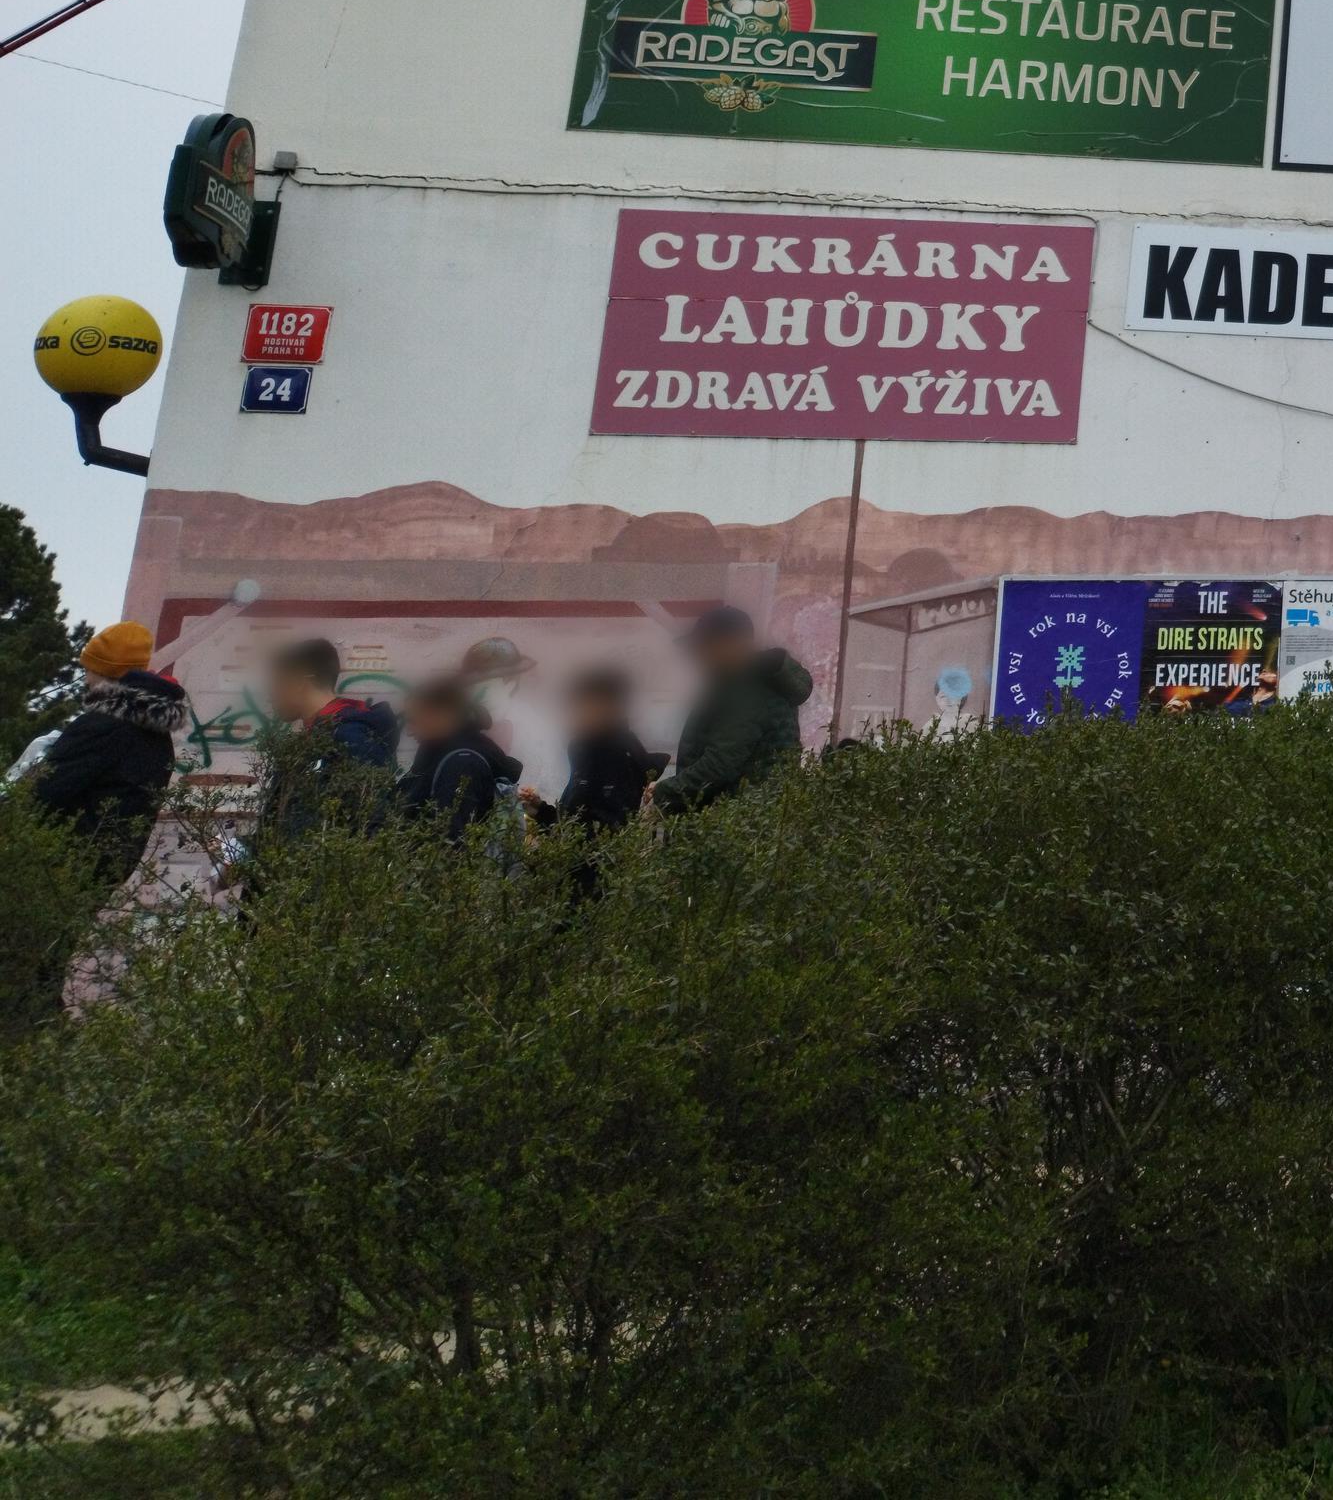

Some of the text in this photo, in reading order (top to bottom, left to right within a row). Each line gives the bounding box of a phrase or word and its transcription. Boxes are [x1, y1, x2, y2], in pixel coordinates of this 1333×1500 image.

[635, 30, 860, 82] RADEGAST
[941, 55, 1200, 110] HARMONY
[205, 175, 254, 236] RADEGA
[638, 231, 1072, 283] CUKRÁRNA
[258, 311, 315, 337] 1182
[658, 291, 1041, 352] LAHŮDKY
[261, 346, 305, 356] PRAHA 10
[258, 377, 292, 402] 24
[612, 365, 1062, 418] ZDRAVÁ VÝŽIVA
[1197, 591, 1229, 614] THE
[1028, 612, 1118, 638] rok na vsi
[1157, 627, 1194, 650] DIRE
[1197, 627, 1264, 651] STRAITS
[1117, 651, 1133, 679] rok
[1155, 663, 1262, 687] EXPERIENCE
